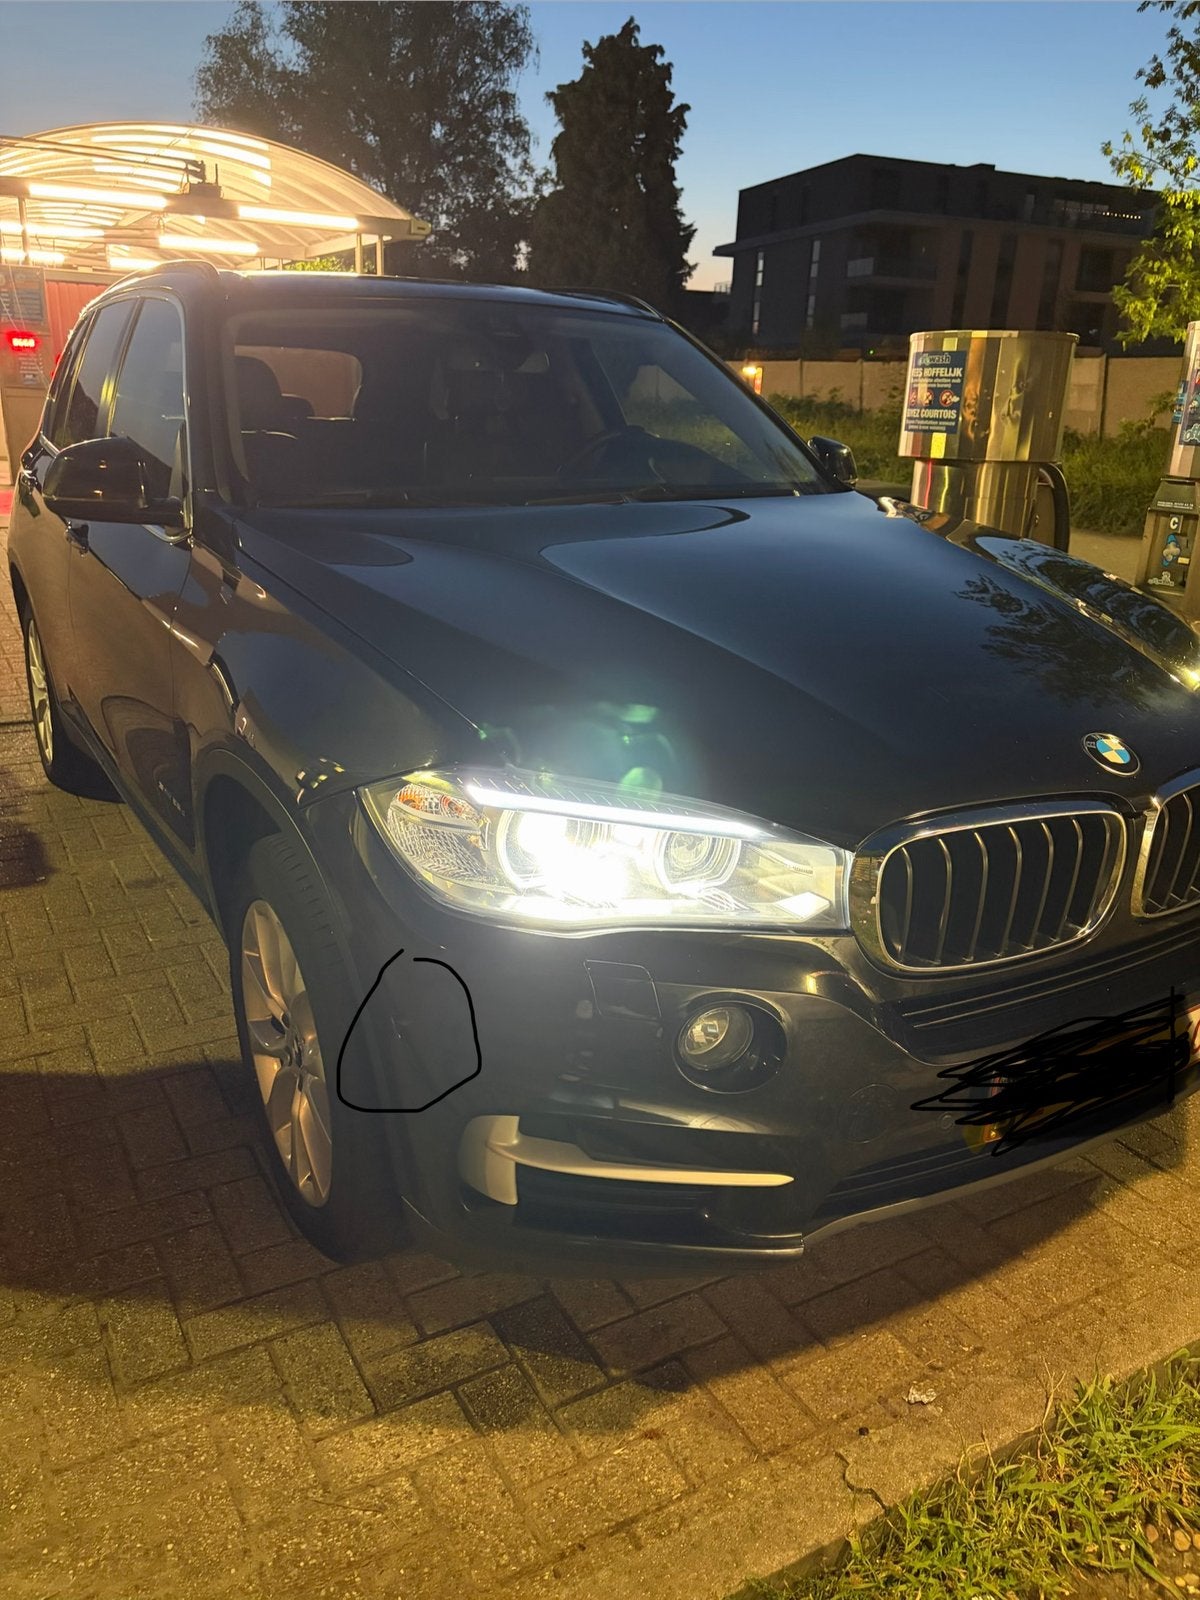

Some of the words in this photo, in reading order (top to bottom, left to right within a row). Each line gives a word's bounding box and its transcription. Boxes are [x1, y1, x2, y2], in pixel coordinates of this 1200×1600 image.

[924, 368, 962, 378] HOFFELIJK
[921, 409, 956, 419] COURTOIS
[1169, 516, 1177, 528] C
